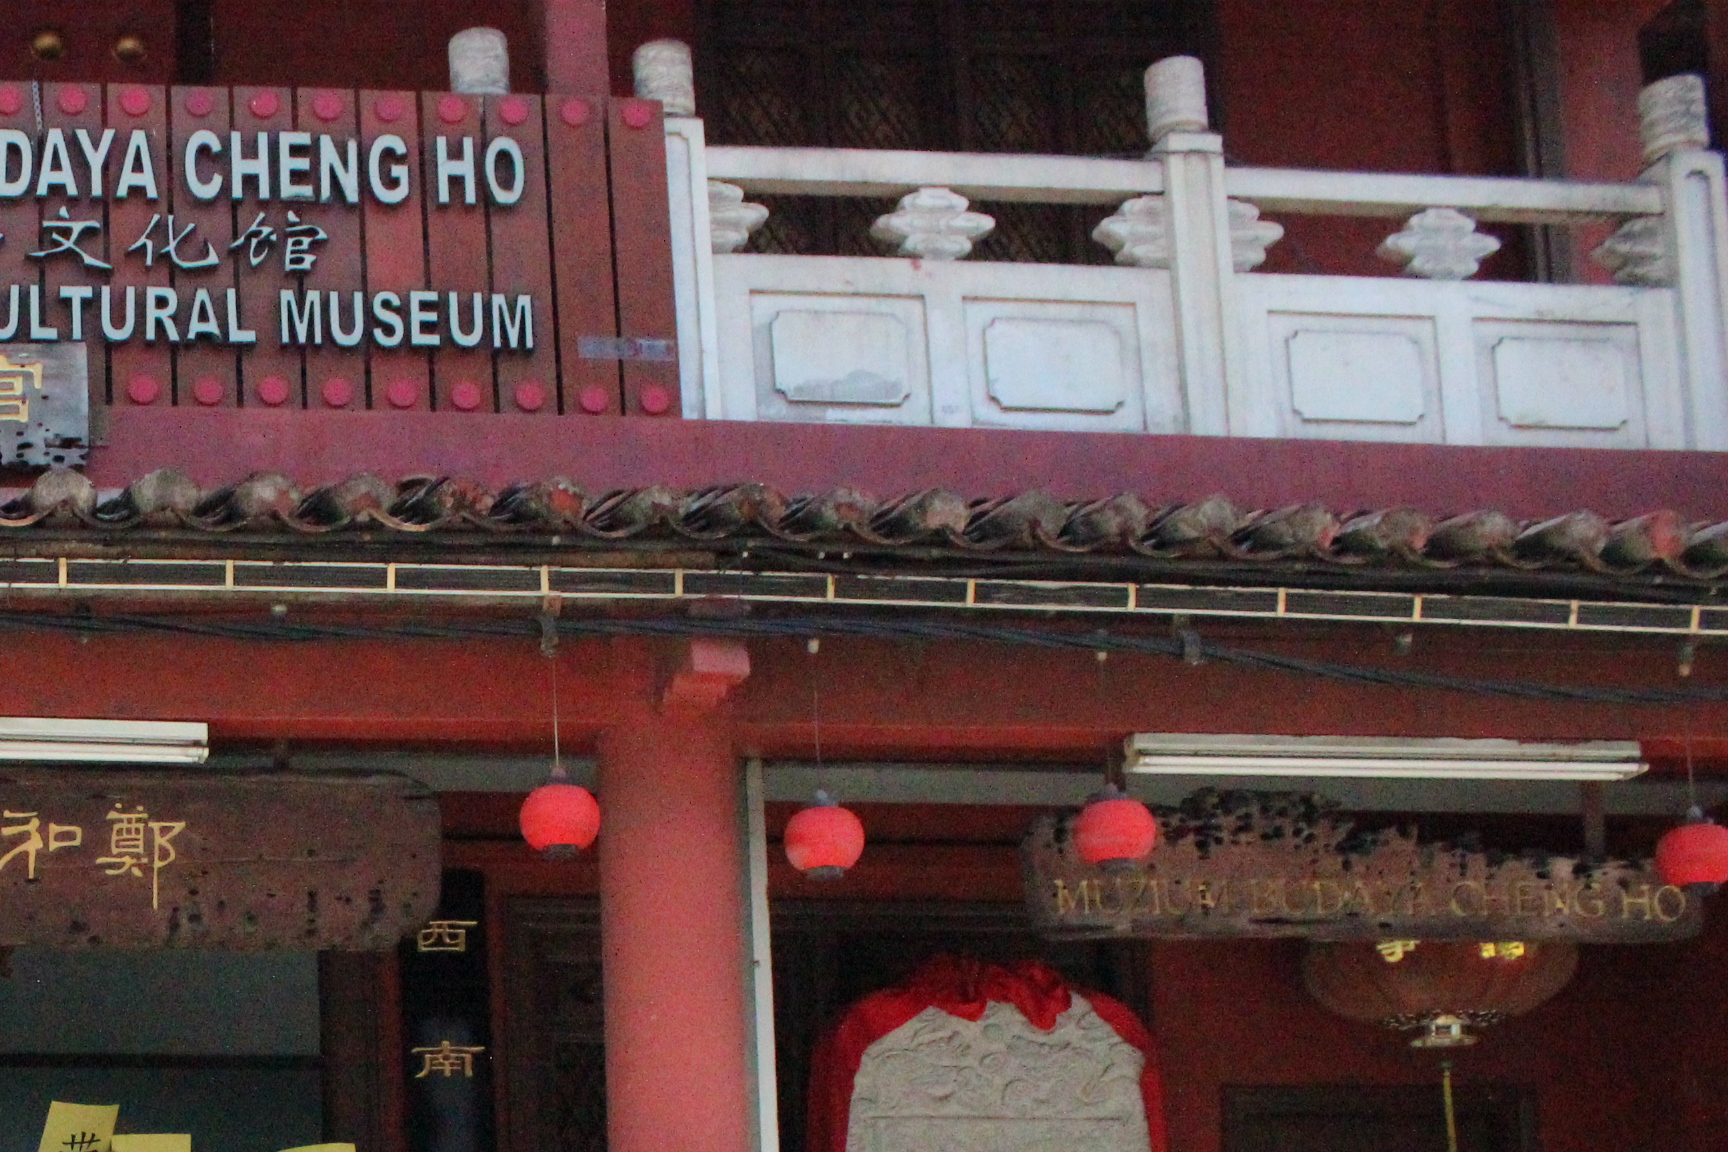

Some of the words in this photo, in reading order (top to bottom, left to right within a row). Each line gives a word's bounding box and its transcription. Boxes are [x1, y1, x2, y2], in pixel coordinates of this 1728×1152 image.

[183, 129, 410, 204] CHENG
[435, 135, 526, 206] HO
[279, 289, 534, 350] MUSEUM
[1450, 880, 1605, 917] CHENG
[1622, 884, 1686, 922] HO
